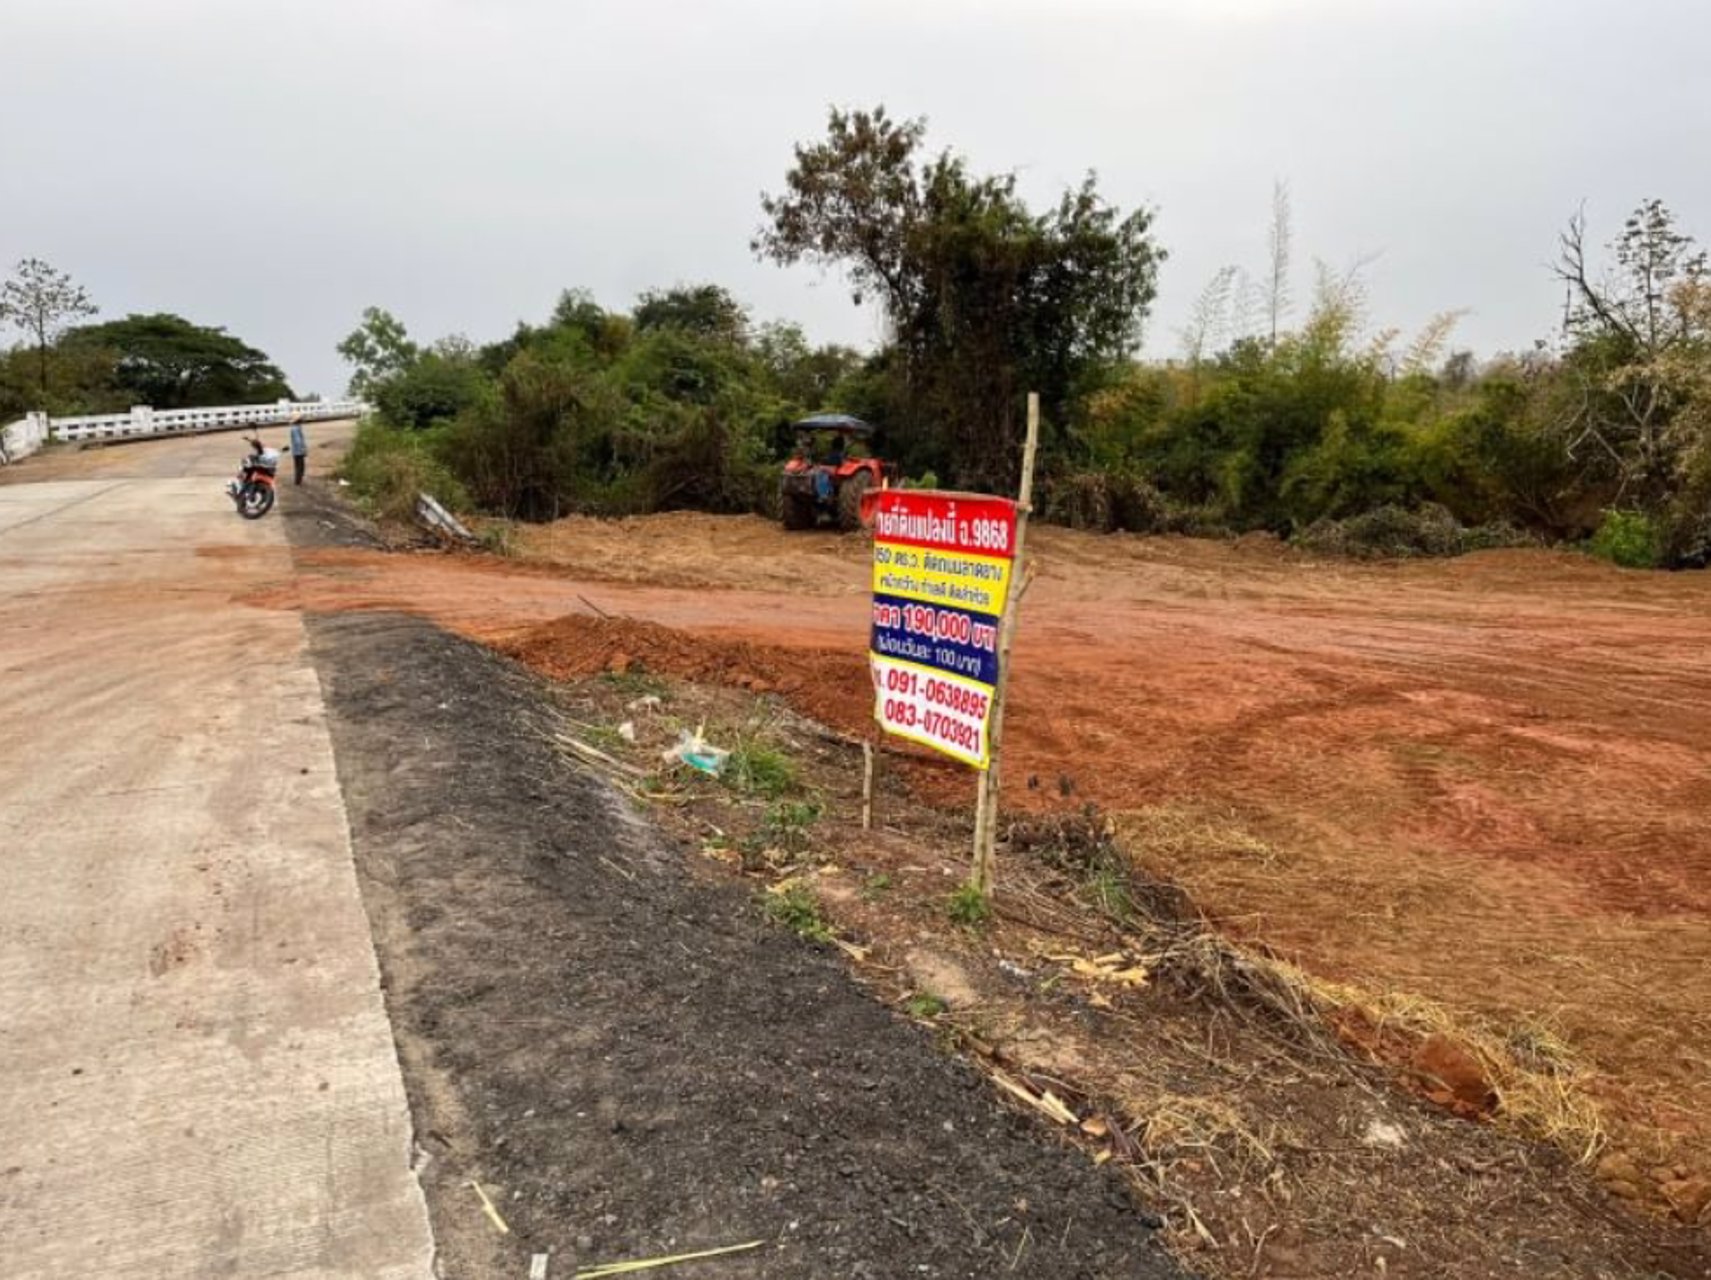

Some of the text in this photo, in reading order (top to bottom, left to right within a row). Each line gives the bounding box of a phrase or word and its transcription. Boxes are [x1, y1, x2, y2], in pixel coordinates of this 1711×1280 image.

[876, 496, 956, 544] ายที่ดินแปลงนี้
[902, 603, 972, 644] 190,000
[935, 648, 955, 666] 100
[888, 669, 988, 720] 091-0638895
[885, 699, 981, 753] 083-0703921
